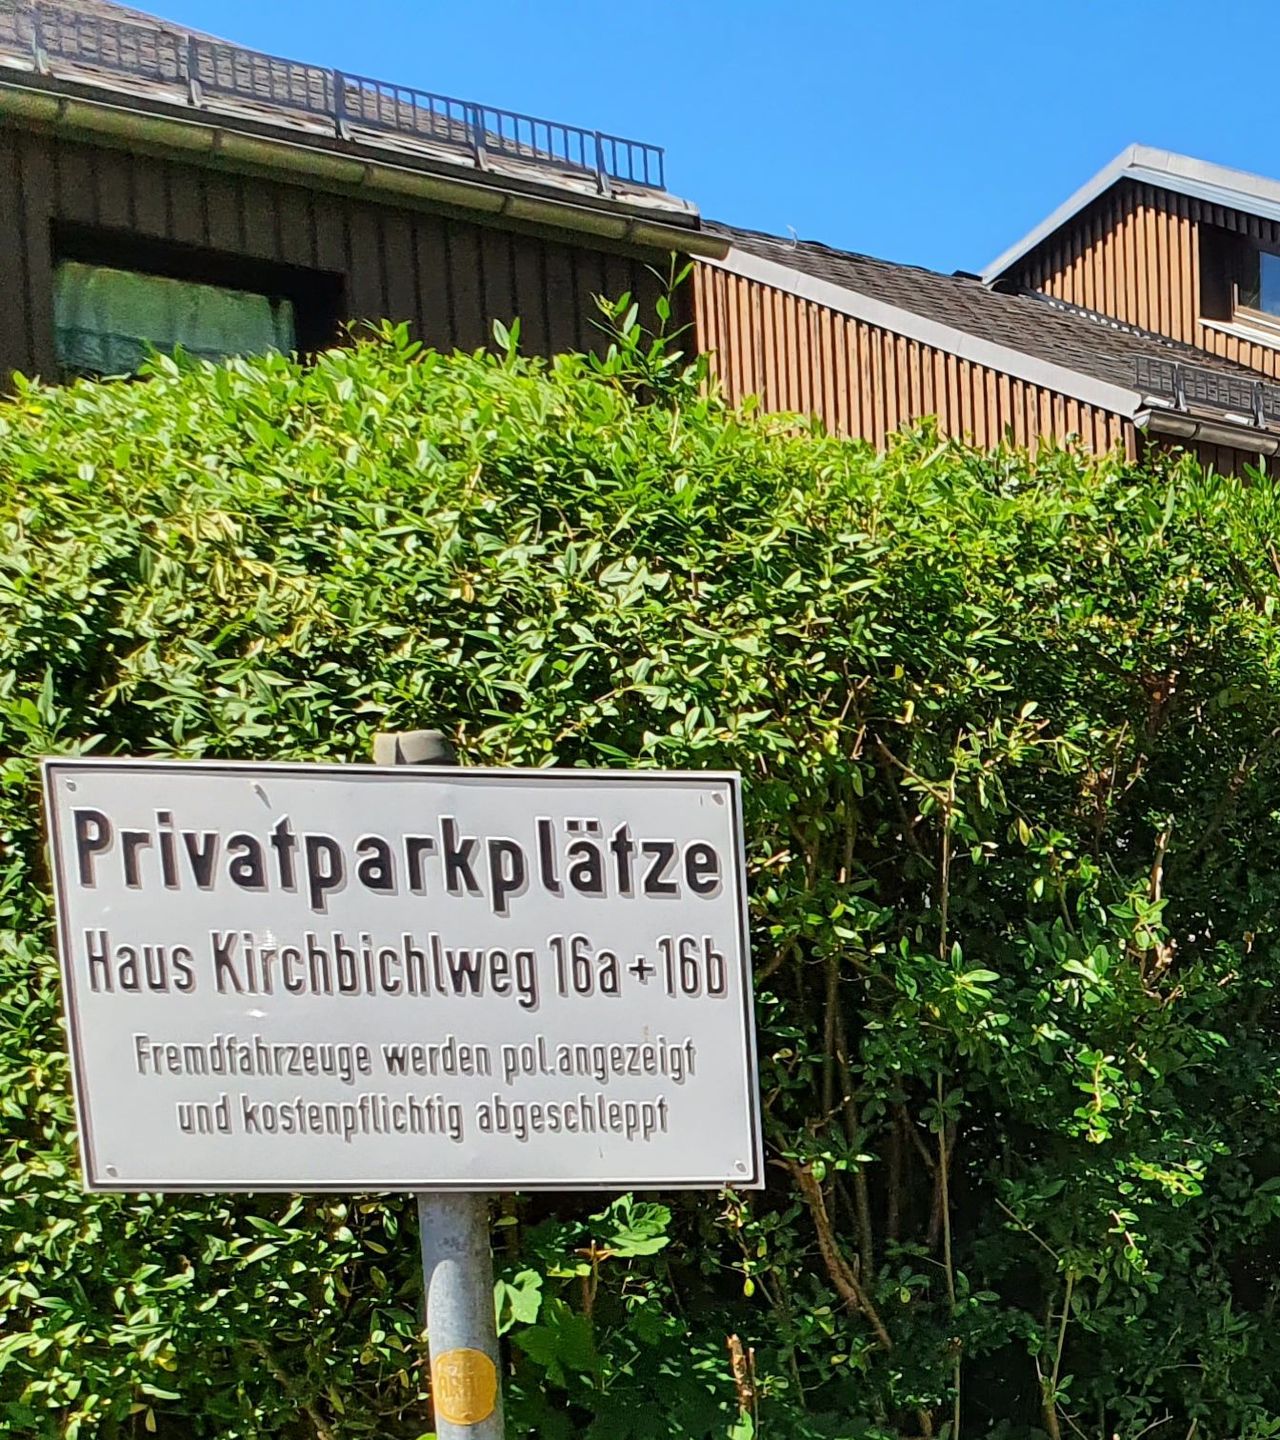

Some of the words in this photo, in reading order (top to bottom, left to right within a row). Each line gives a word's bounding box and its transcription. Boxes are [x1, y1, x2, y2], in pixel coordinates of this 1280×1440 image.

[72, 806, 722, 916] Privatparkplätze
[83, 928, 197, 993] Haus
[208, 929, 540, 1009] Kirchbichlweg
[133, 1033, 372, 1085] Fremdfahrzeuge
[381, 1034, 492, 1077] werden
[175, 1091, 232, 1134] und
[240, 1093, 464, 1143] kostenpflichtig
[475, 1092, 669, 1141] abgeschleppt
